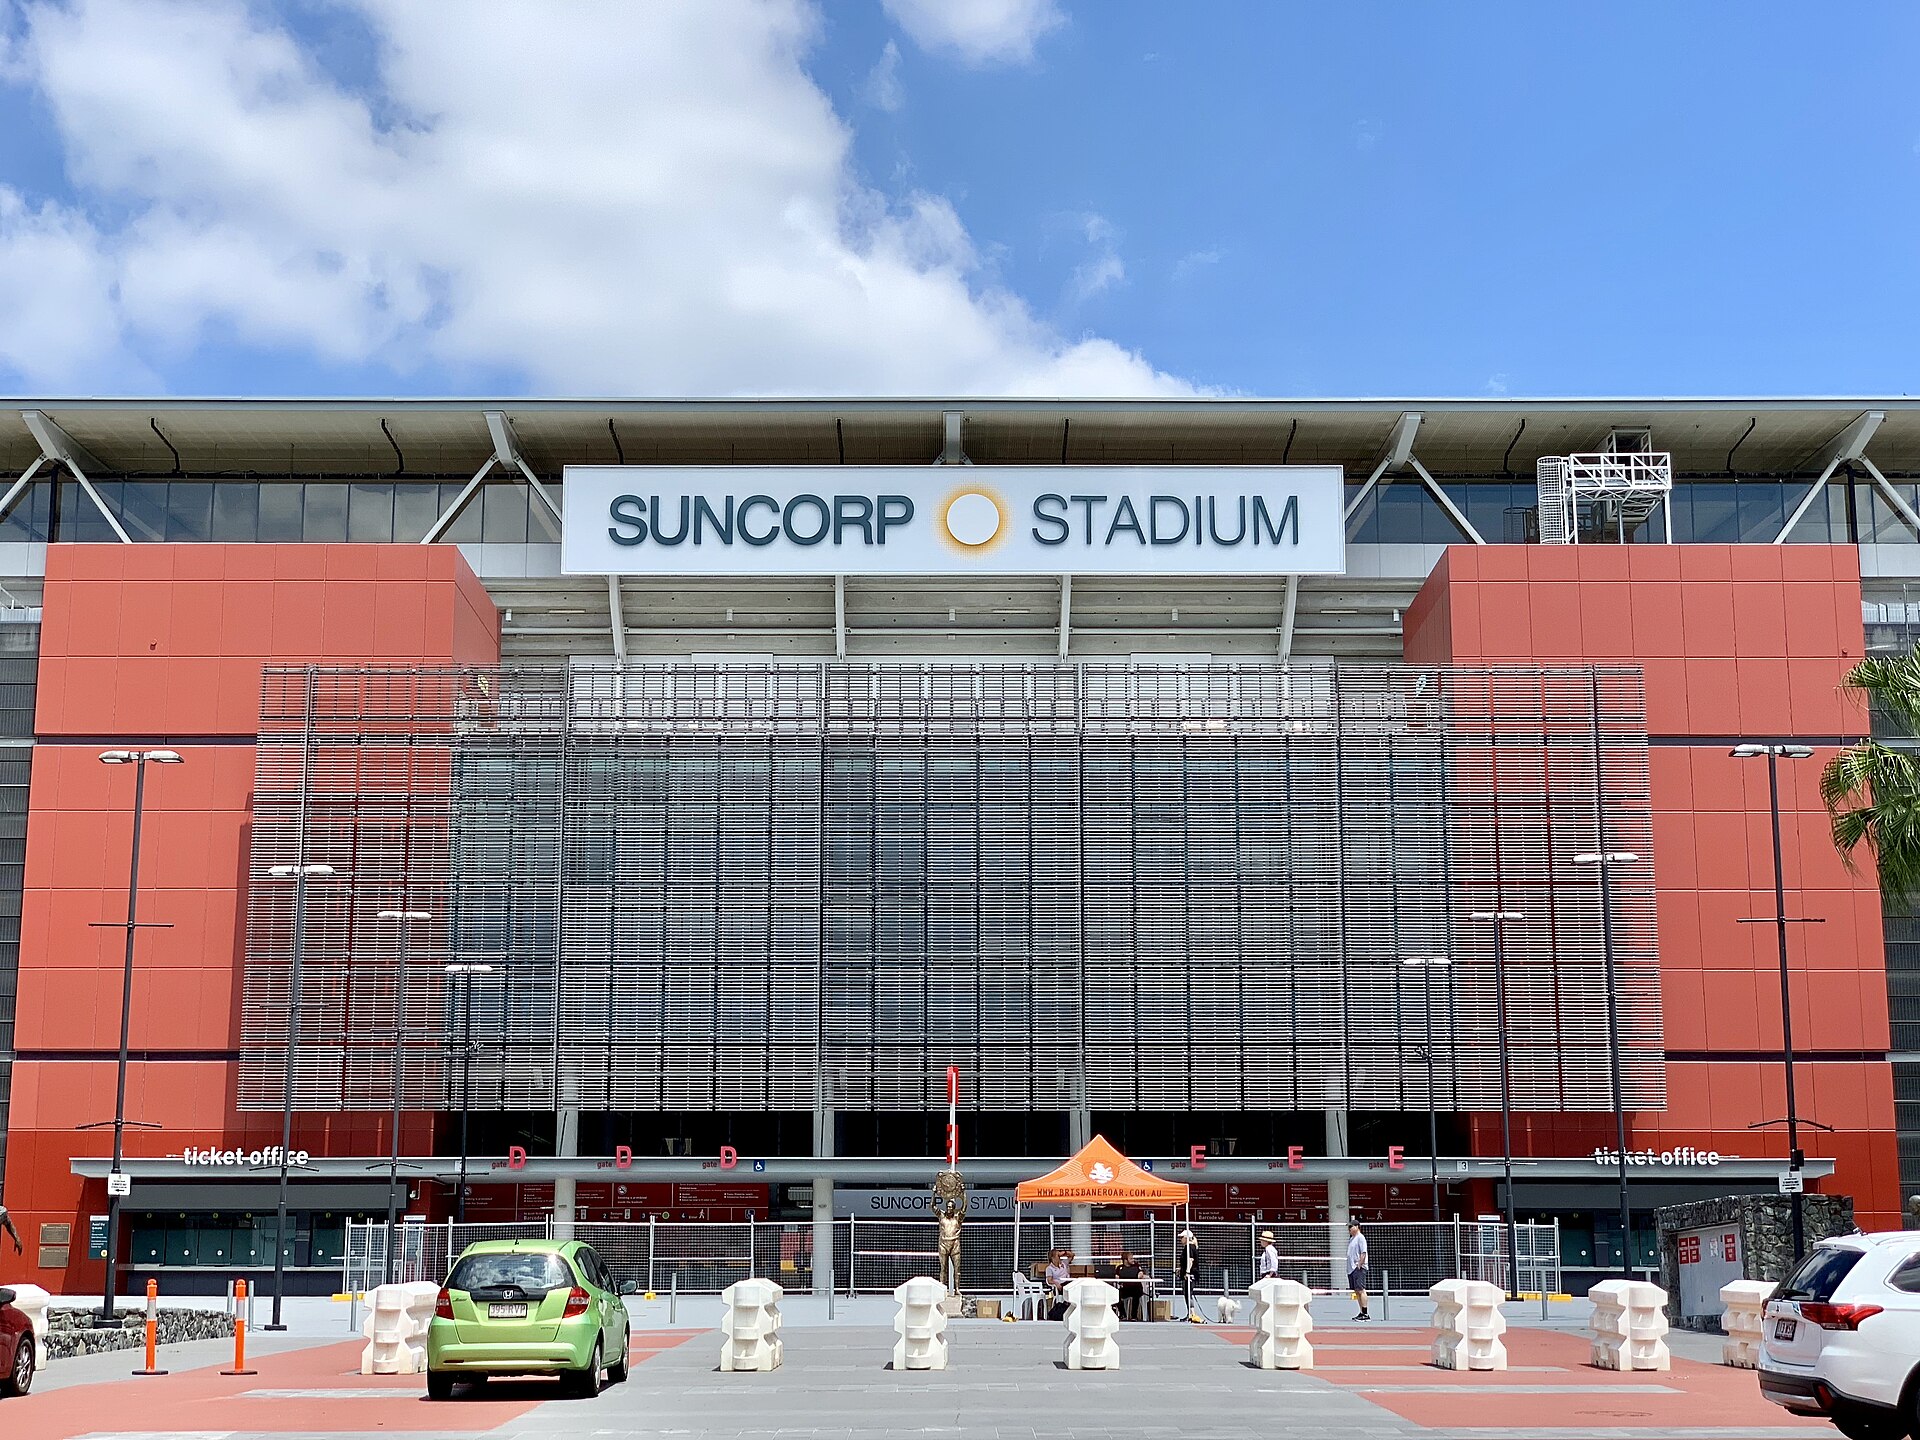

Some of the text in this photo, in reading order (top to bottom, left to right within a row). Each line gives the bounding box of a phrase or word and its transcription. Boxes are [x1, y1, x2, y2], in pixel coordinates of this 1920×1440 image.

[607, 493, 1300, 547] SUNCORP STADIUM
[184, 1146, 309, 1165] ticket office
[491, 1146, 526, 1169] gate D
[597, 1145, 632, 1169] gate D
[702, 1146, 737, 1169] gate D
[1170, 1145, 1207, 1170] gate E
[1267, 1146, 1304, 1170] gate E
[1368, 1146, 1404, 1170] gate E
[1461, 1161, 1467, 1170] 3
[1594, 1146, 1720, 1165] ticket office
[1037, 1188, 1162, 1198] WWW.BRISBANEROAR.COM.AU
